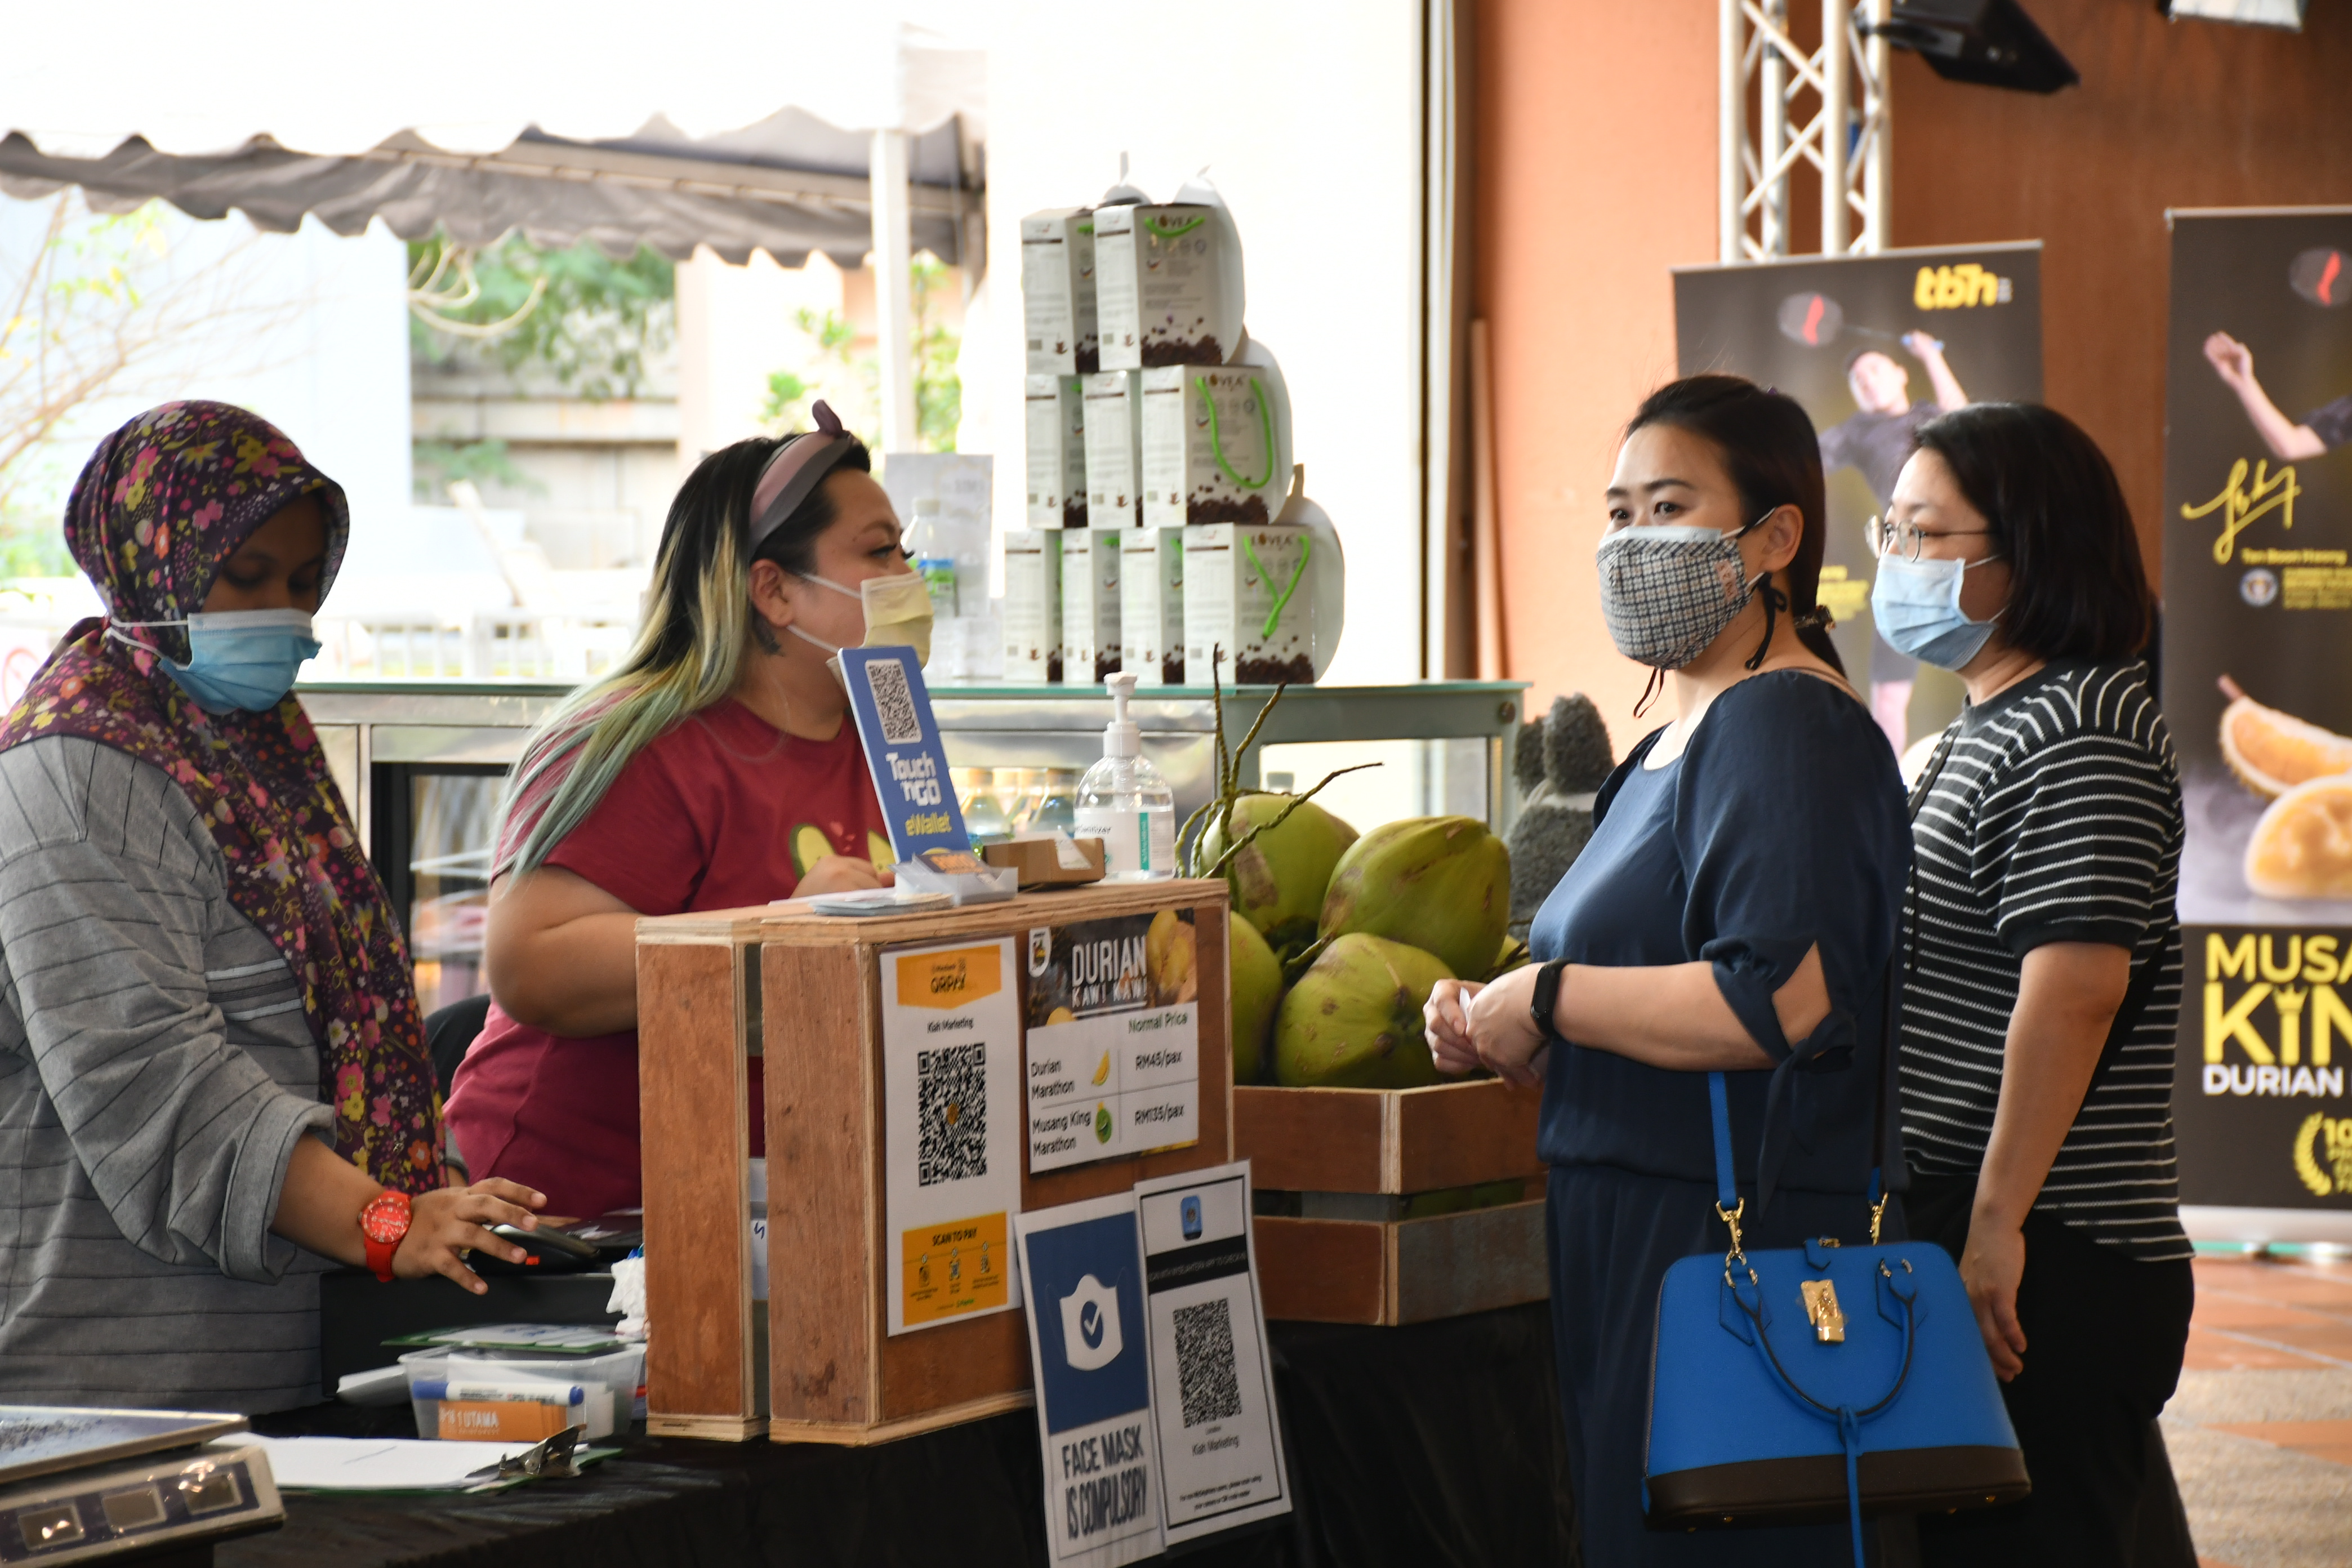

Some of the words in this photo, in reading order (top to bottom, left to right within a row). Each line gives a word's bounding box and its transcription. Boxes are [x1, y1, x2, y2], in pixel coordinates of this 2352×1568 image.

[885, 751, 936, 781] Touch
[905, 811, 952, 836] eWallet
[1072, 934, 1147, 987] DURIAN
[1072, 982, 1106, 1008] KAWI
[942, 1016, 974, 1031] Marketing
[1129, 1014, 1162, 1034] Normal
[1165, 1012, 1188, 1028] Price
[1031, 1058, 1062, 1077] Durian
[1135, 1048, 1182, 1070] RM45/pax
[1031, 1079, 1075, 1100] Marathon
[2203, 1063, 2343, 1097] DURIAN
[1032, 1116, 1068, 1134] Musang
[1070, 1109, 1092, 1127] King
[1134, 1102, 1184, 1125] RM135/pax
[1033, 1136, 1076, 1157] Marathon
[932, 1232, 952, 1246] SCAN
[953, 1230, 962, 1242] TO
[964, 1227, 978, 1240] PAY
[464, 1410, 500, 1427] UTAMA
[1062, 1437, 1101, 1480] FACE
[1101, 1423, 1144, 1467] MASK
[1207, 1435, 1239, 1452] Marketing
[1065, 1485, 1079, 1540] IS
[1079, 1464, 1147, 1536] COMPULSORY
